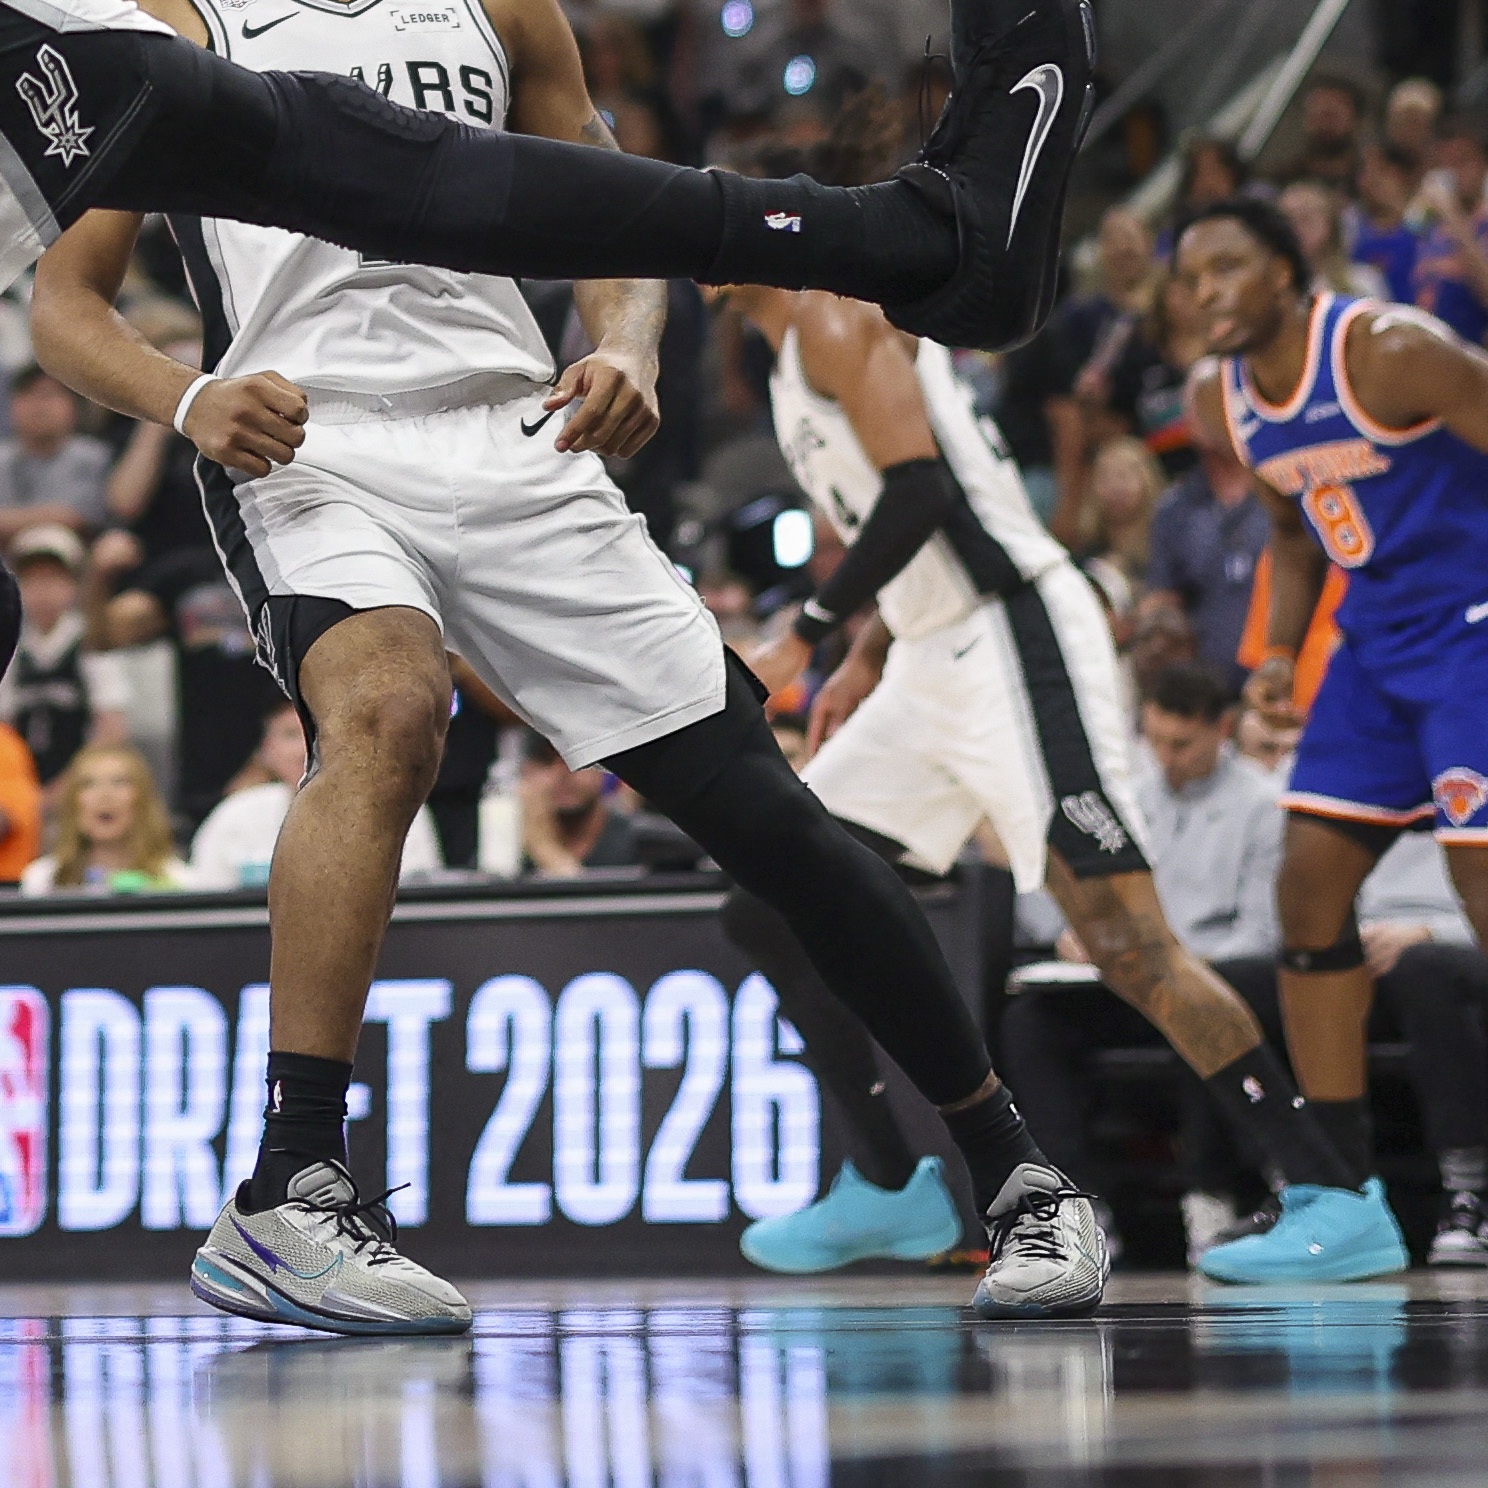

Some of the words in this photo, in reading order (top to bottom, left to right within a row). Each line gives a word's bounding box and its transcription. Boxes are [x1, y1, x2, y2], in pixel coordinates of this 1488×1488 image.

[401, 13, 450, 24] LEDGER
[1304, 485, 1374, 566] 8
[464, 969, 821, 1226] 2026
